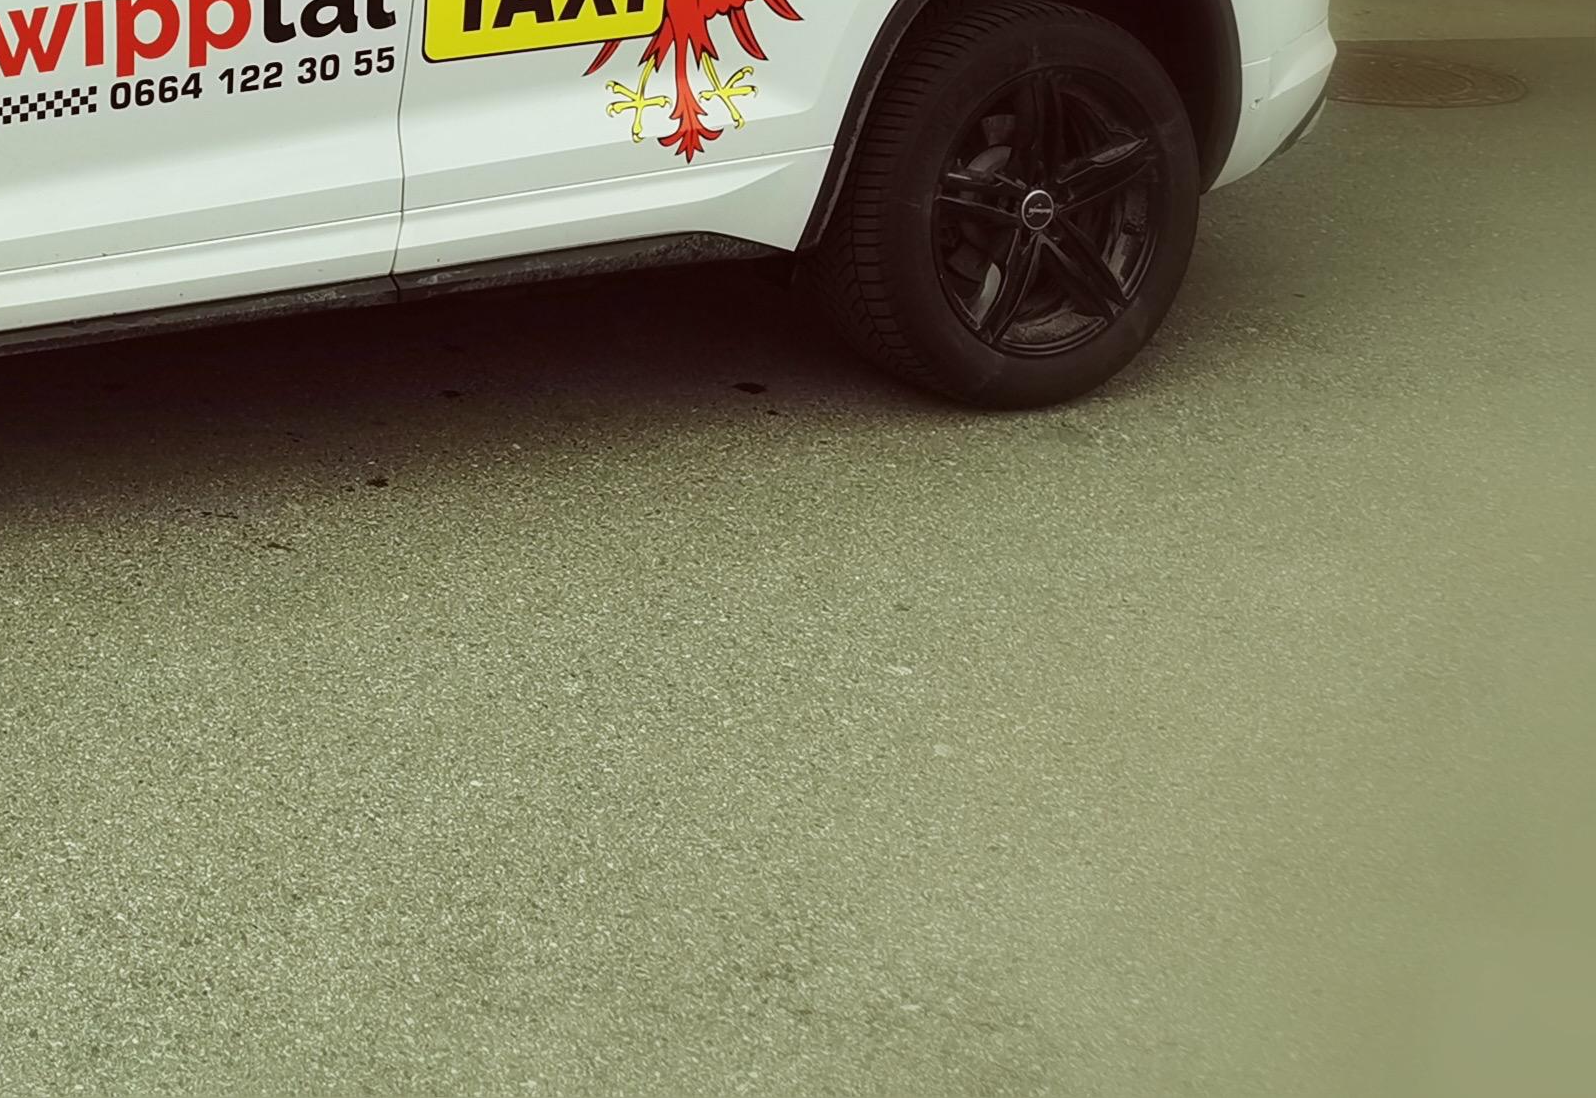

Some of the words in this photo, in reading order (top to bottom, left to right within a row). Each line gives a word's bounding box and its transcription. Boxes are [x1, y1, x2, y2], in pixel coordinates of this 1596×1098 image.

[110, 72, 203, 110] 0664
[217, 61, 283, 95] 122
[297, 53, 341, 85] 30
[354, 46, 396, 77] 55
